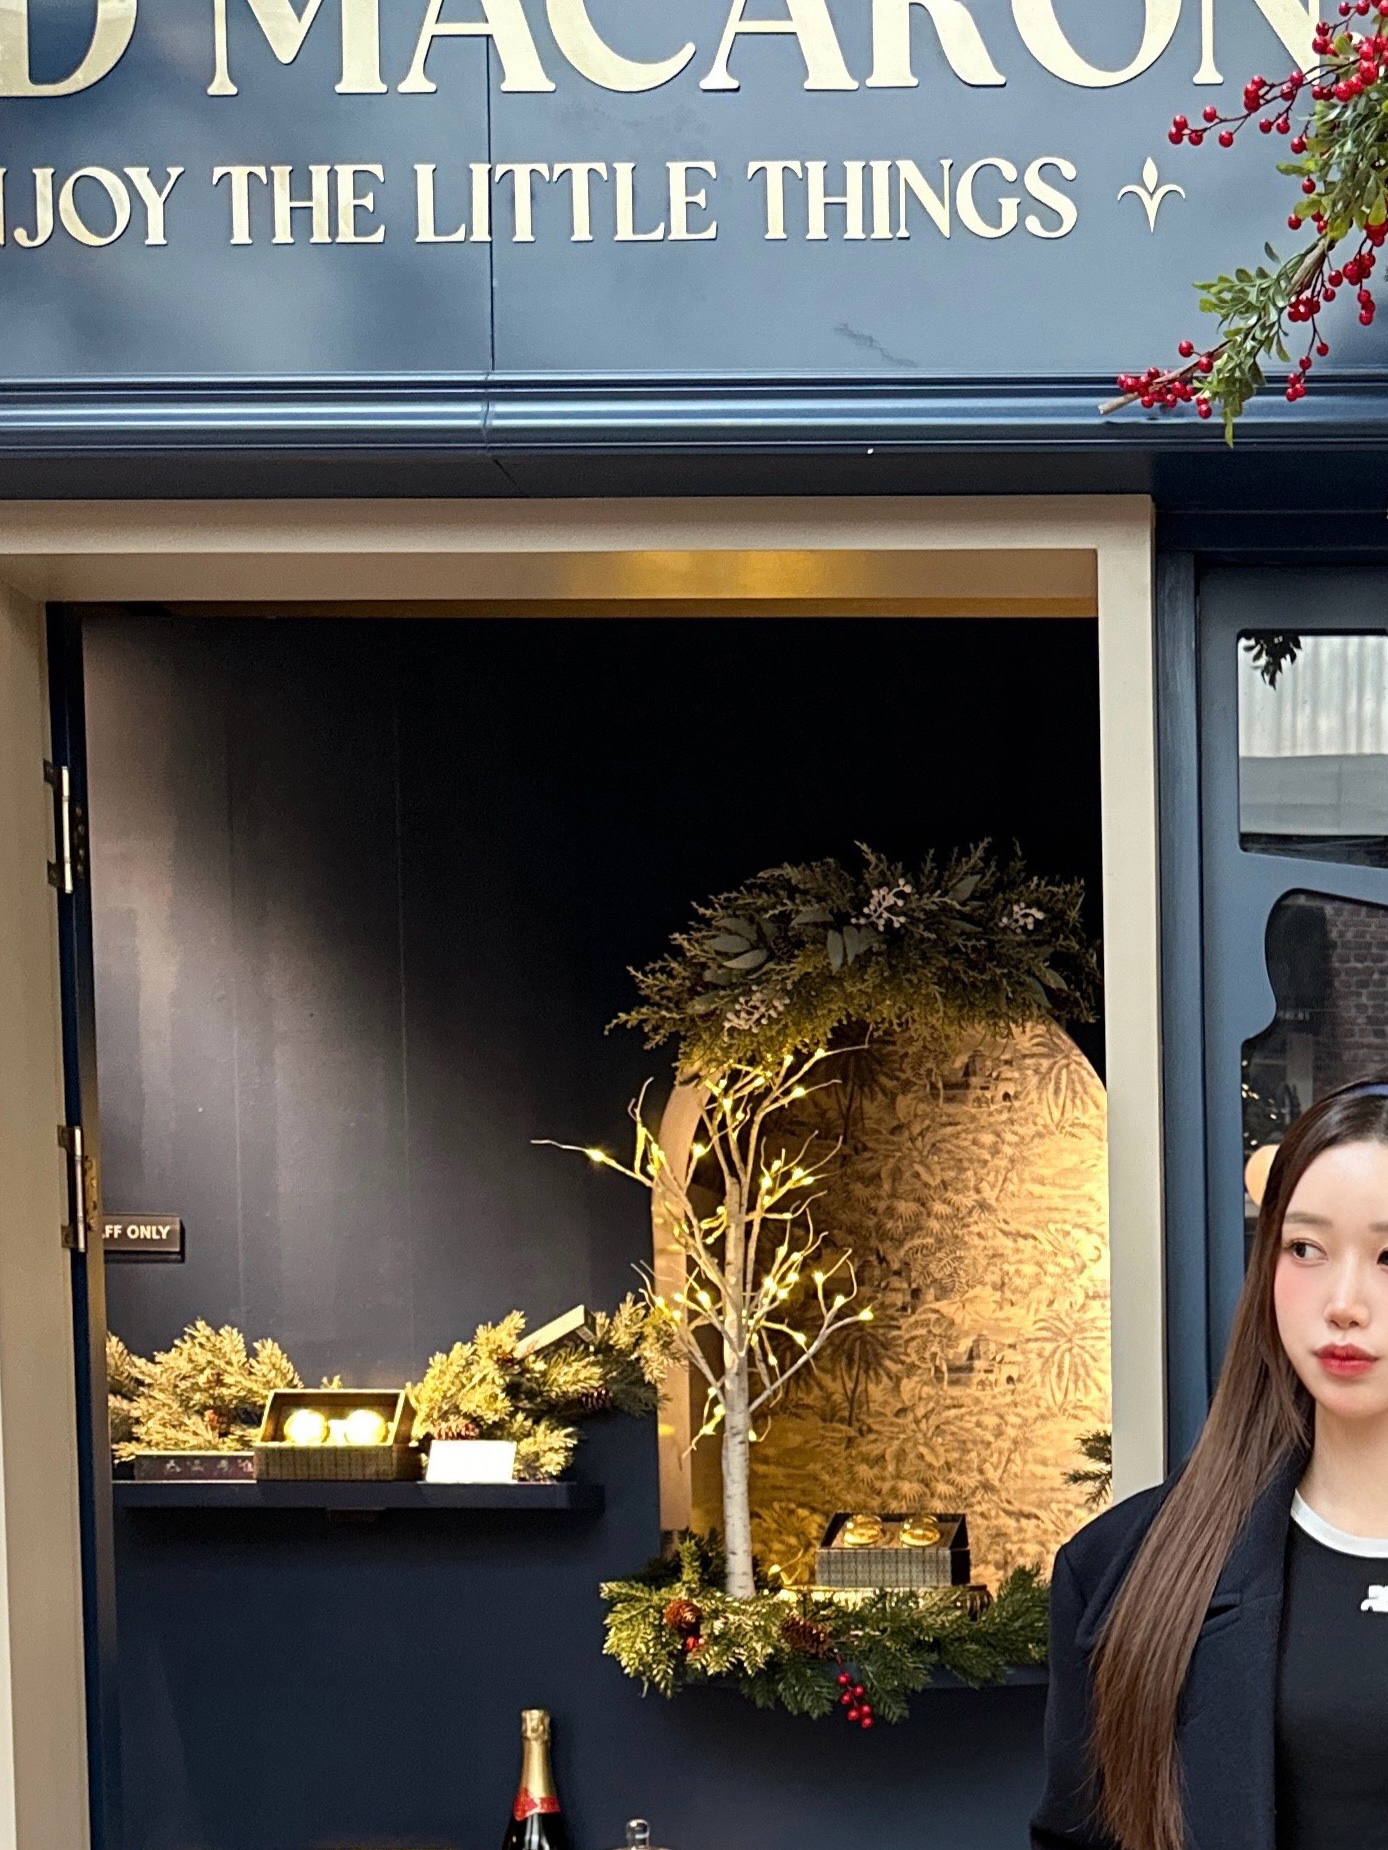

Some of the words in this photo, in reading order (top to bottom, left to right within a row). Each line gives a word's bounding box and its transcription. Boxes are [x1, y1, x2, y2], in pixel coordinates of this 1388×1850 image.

[0, 166, 185, 248] JOY
[212, 164, 386, 245] THE
[413, 161, 718, 243] LITTLE
[747, 157, 1079, 239] THINGS
[126, 1225, 171, 1240] ONLY
